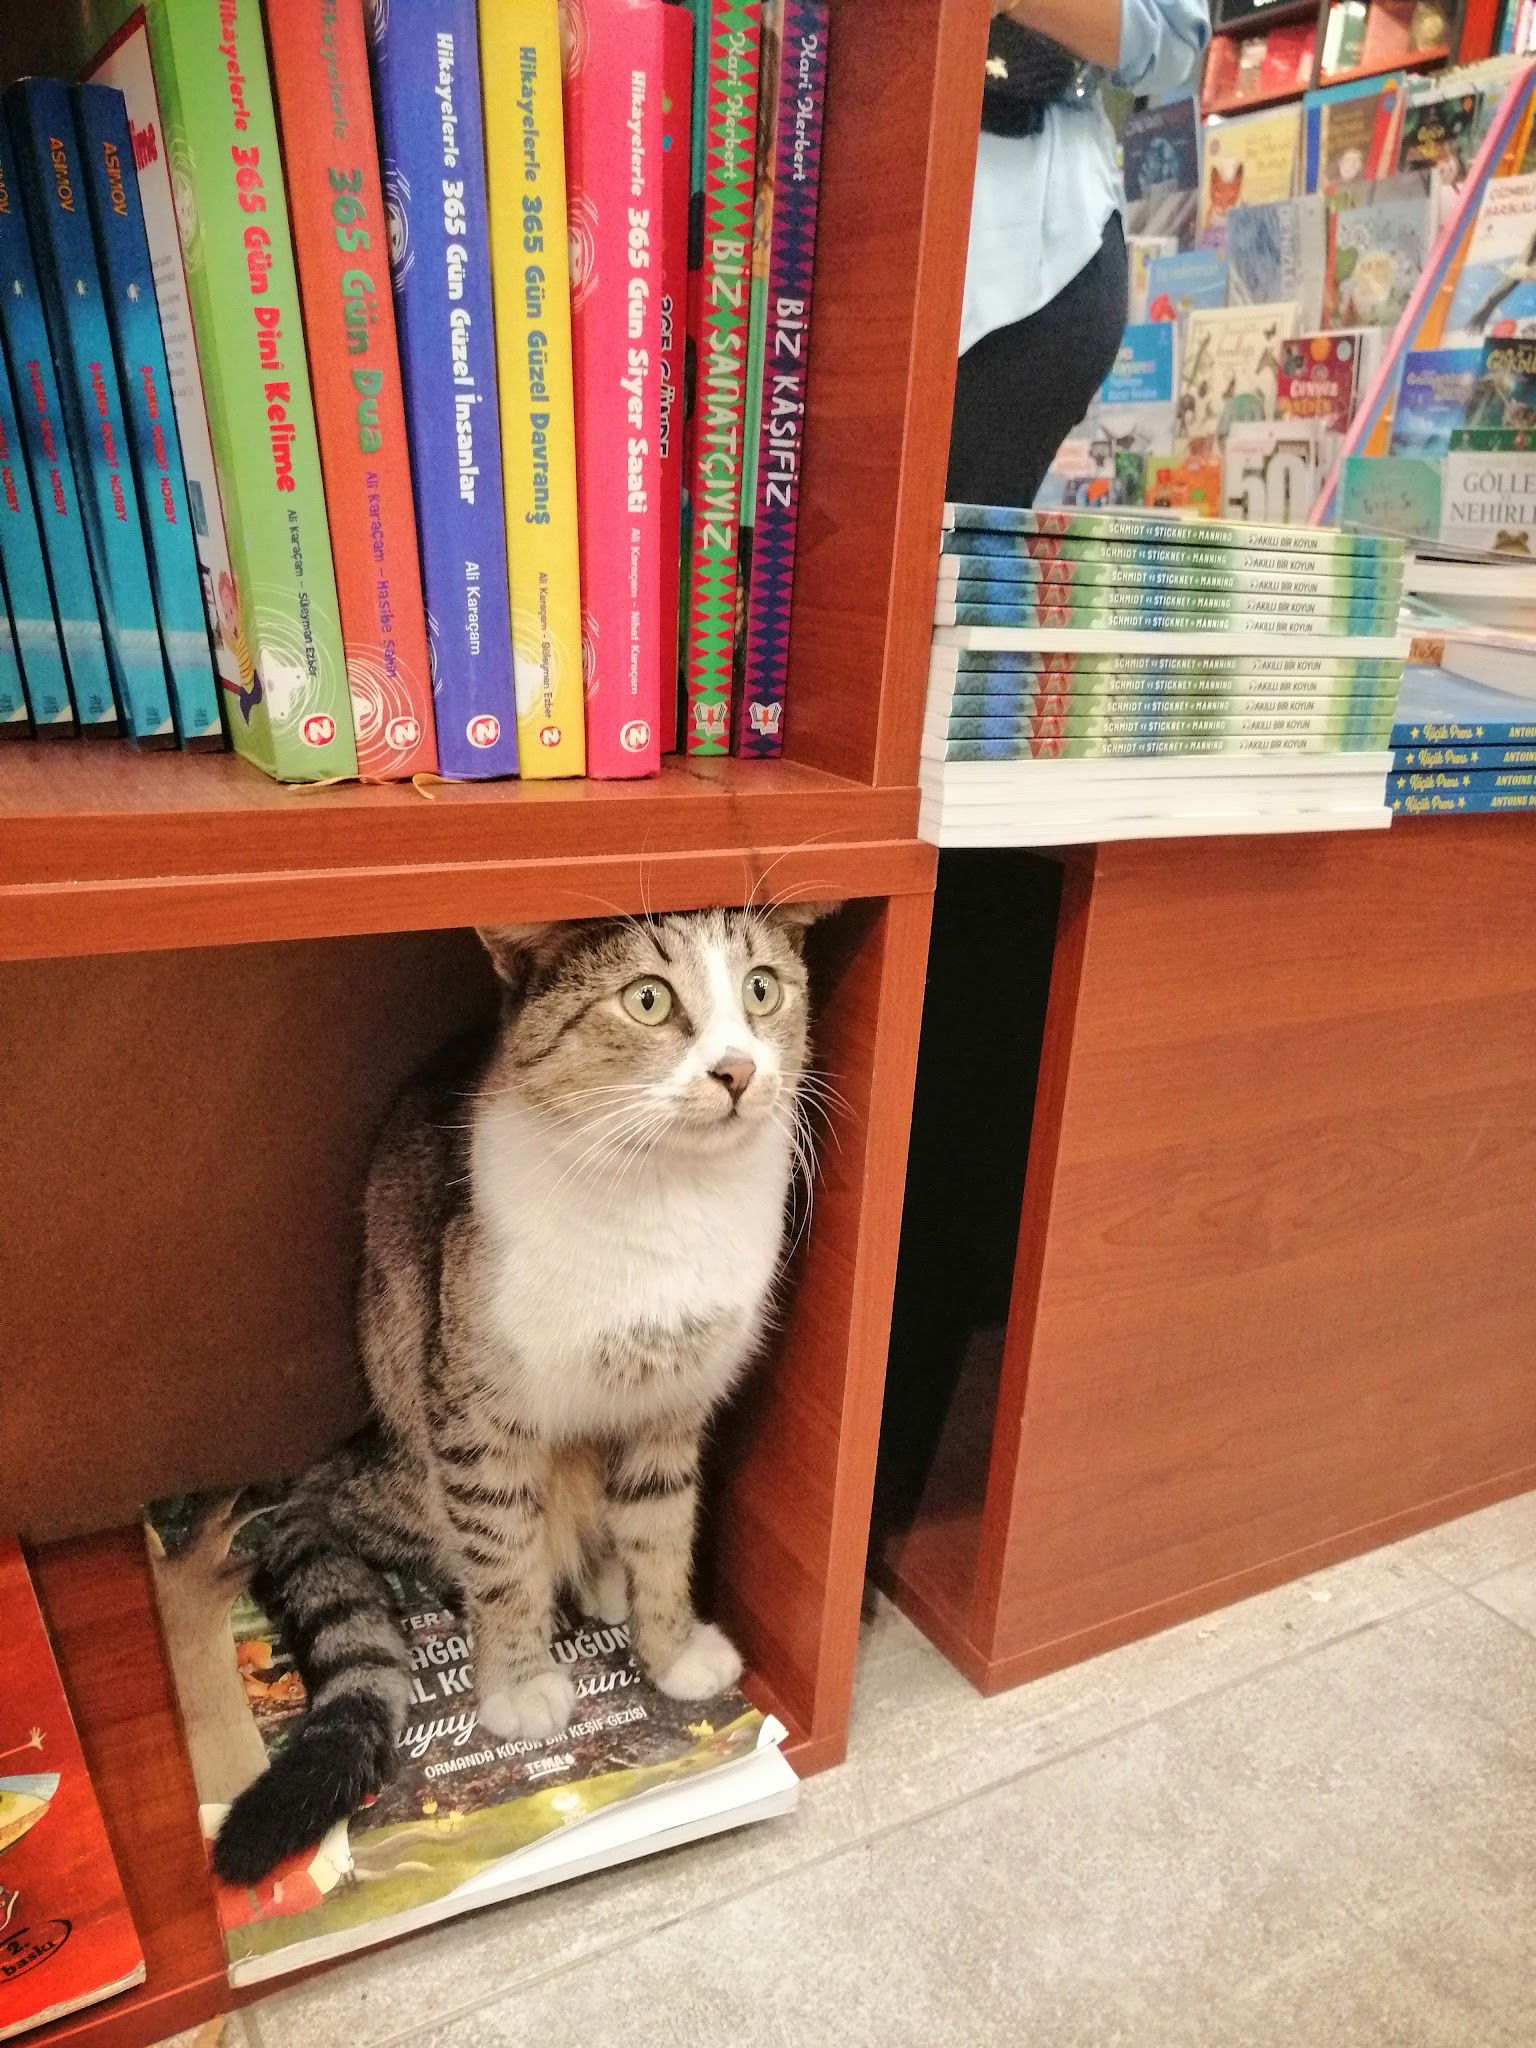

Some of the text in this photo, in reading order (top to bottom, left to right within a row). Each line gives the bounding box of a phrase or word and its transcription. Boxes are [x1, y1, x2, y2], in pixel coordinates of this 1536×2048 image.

[723, 31, 746, 181] Kari Herbert
[793, 34, 818, 181] Kari Herbert
[50, 136, 75, 211] ASIMOV
[103, 142, 128, 216] ASIMOV
[231, 145, 266, 214] 365
[328, 168, 370, 253] 365
[243, 226, 271, 294] Gün
[435, 32, 483, 505] Hikâyelerle 365 Gün Güzel İnsanlar
[517, 47, 551, 525] Hikâyelerle 365 Gün Güzel Davranış
[620, 70, 650, 514] Hikâyelerle 365 Gün Siyer Saati
[342, 269, 378, 355] Gün
[254, 306, 284, 371] Dini
[352, 369, 383, 454] Dua
[697, 239, 750, 551] BİZ SANATÇIYIZ
[762, 298, 808, 508] BİZ KÂŞİFİZ
[264, 382, 296, 493] Kelime
[364, 471, 378, 489] Ali
[109, 475, 127, 522] NORBY
[160, 477, 177, 525] NORBY
[1110, 523, 1232, 543] SCHMIDT STICKNEY MANNING
[1293, 538, 1318, 549] KOYUN
[1101, 547, 1227, 564] SCHMIDT STICKNEY MANNING
[1290, 560, 1315, 570] KOYUN
[287, 509, 316, 678] Ali Karaçam Süleyman Ezber
[1112, 570, 1234, 588] SCHMIDT STICKNEY MANNING
[1293, 582, 1318, 592] KOYUN
[464, 561, 481, 656] Ali Karaçam
[629, 527, 641, 694] Ali Karaçam Nihat Karaçam
[1110, 592, 1231, 609] SCHMIDT STICKNEY MANNING
[1290, 603, 1315, 613] KOYUN
[1110, 615, 1230, 629] SCHMIDT STICKNEY MANNING
[1289, 623, 1313, 633] KOYUN
[538, 572, 548, 583] Ali
[543, 693, 552, 719] Ezber
[1114, 658, 1237, 669] SCHMIDT STICKNEY MANNING
[1297, 660, 1321, 671] KOYUN
[1110, 679, 1232, 690] SCHMIDT STICKNEY MANNING
[1293, 682, 1317, 691] KOYUN
[1107, 701, 1230, 712] SCHMIDT STICKNEY MANNING
[1290, 701, 1315, 711] KOYUN
[1103, 721, 1225, 732] SCHMIDT STICKNEY MANNING
[1286, 719, 1310, 729] KOYUN
[1102, 741, 1224, 753] SCHMIDT STICKNEY MANNING
[1283, 739, 1307, 749] KOYUN
[424, 1749, 495, 1779] ORMANDA
[569, 1718, 607, 1740] KEŞİF
[607, 1705, 648, 1729] GEZİSİ
[524, 1754, 565, 1776] TEMA
[6, 1941, 30, 1956] 2.
